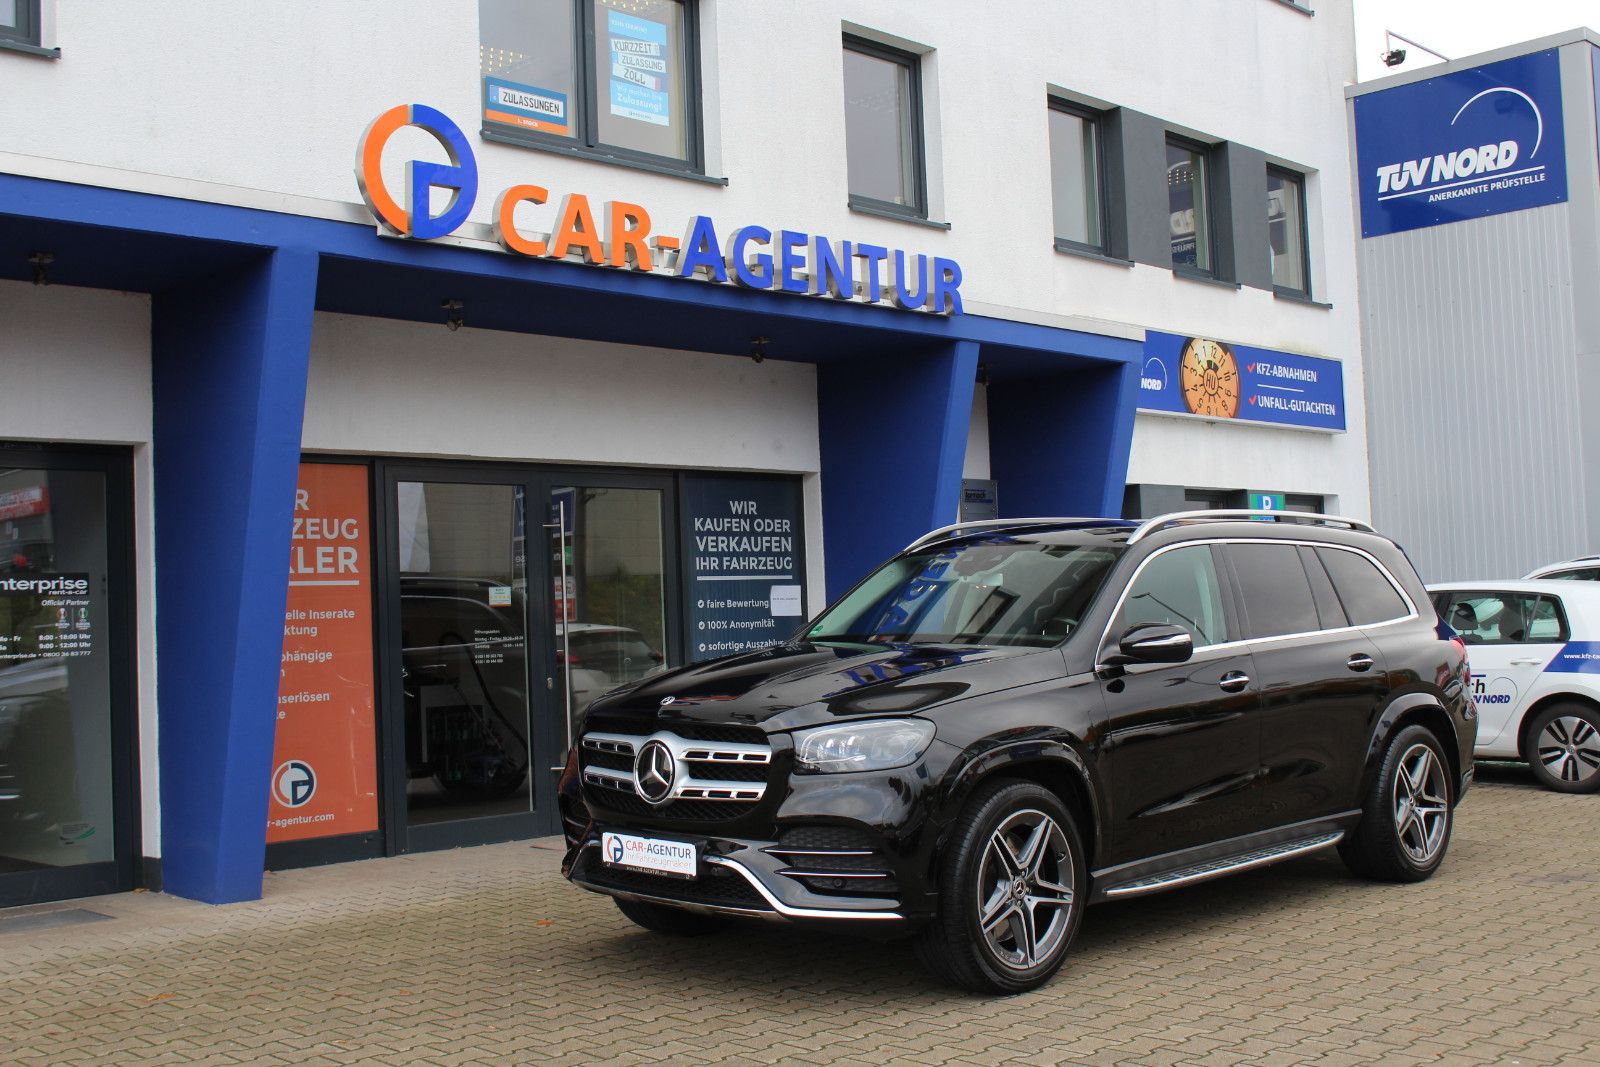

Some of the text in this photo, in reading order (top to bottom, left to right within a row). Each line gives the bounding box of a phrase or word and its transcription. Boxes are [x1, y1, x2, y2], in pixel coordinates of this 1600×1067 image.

[613, 40, 652, 54] KURZZEIT
[621, 54, 663, 71] ZULASSUNG
[623, 68, 646, 85] ZOLL
[502, 91, 560, 114] ZULASSUNGEN
[1375, 139, 1519, 194] TÜV NORD
[1428, 172, 1546, 203] ANERKANNTE PRÜFSTELLE
[496, 184, 963, 316] CAR-AGENTUR
[1210, 345, 1218, 359] 12
[1256, 361, 1318, 383] KFZ-ABNAHMEN
[1140, 377, 1162, 391] NORD
[1205, 372, 1217, 390] HU
[1257, 394, 1336, 416] UNFALL-GUTACHTEN
[729, 500, 758, 515] WIR
[694, 517, 791, 533] KAUFEN ODER
[695, 536, 792, 553] VERKAUFEN
[289, 546, 359, 574] LER
[695, 556, 793, 571] IHR FAHRZEUG
[41, 599, 65, 607] Official
[706, 598, 769, 610] faire Bewertung
[309, 608, 355, 620] Inserate
[707, 617, 775, 631] 100% Anonymität
[708, 641, 744, 653] sofortige
[1482, 694, 1511, 704] NORD
[625, 839, 692, 859] CAR-AGENTUR
